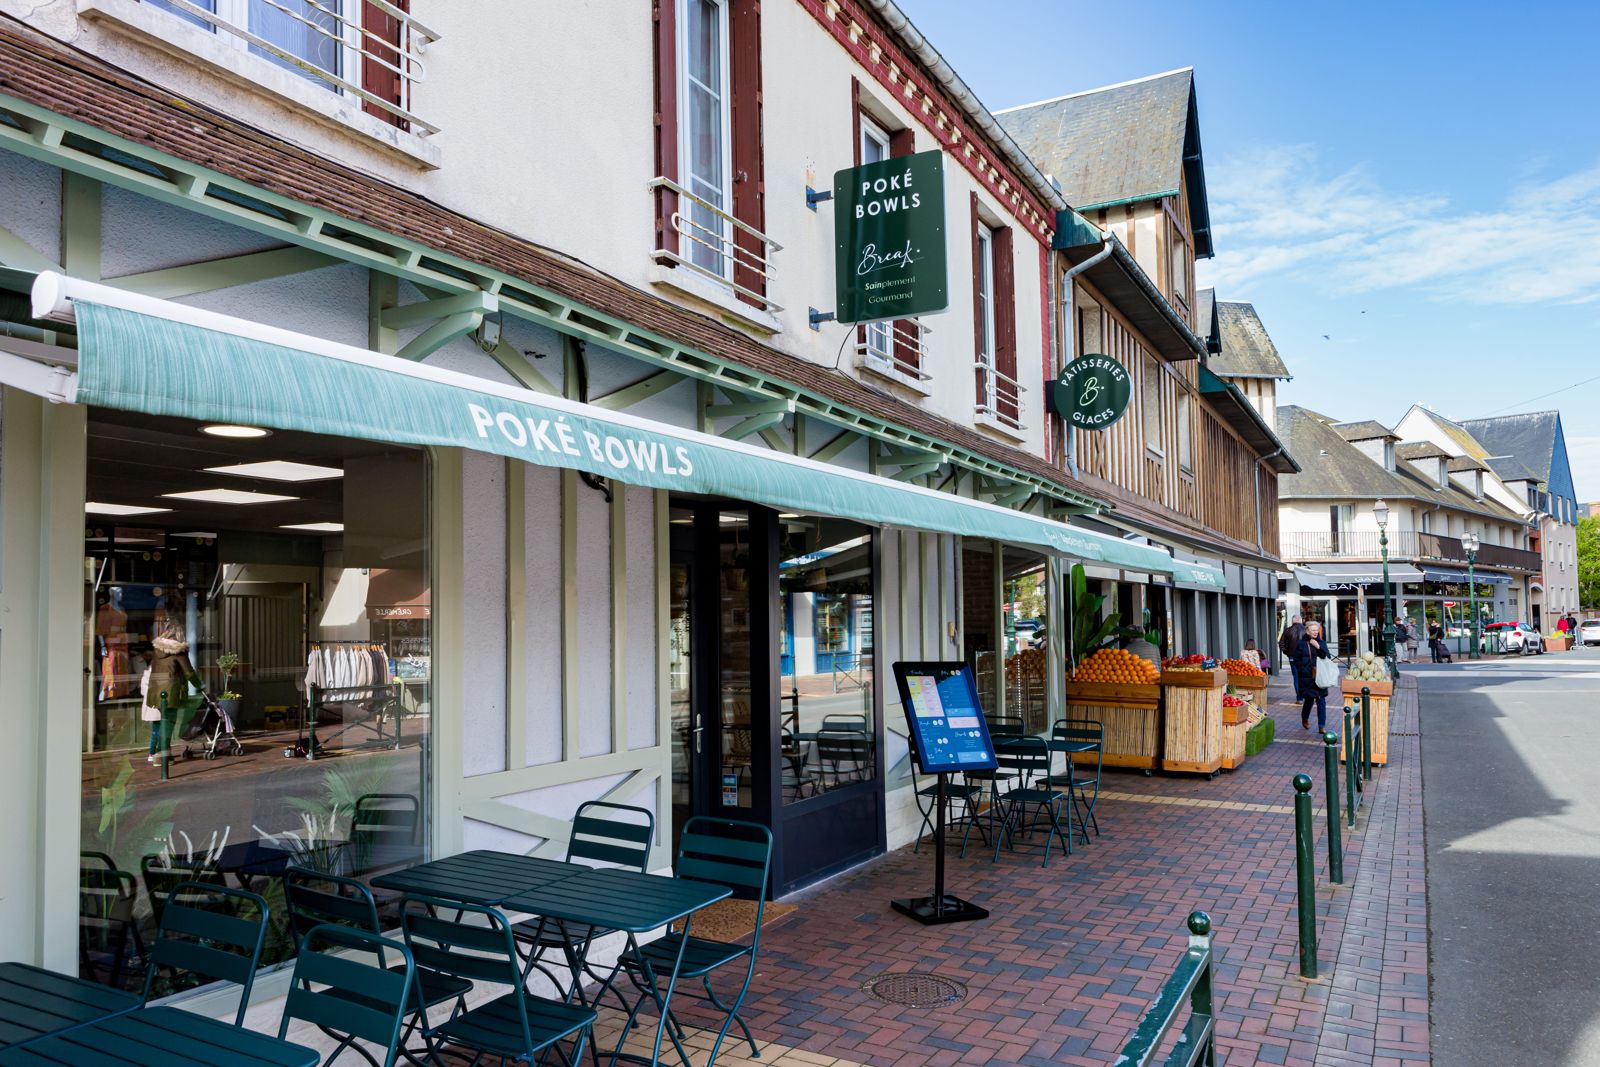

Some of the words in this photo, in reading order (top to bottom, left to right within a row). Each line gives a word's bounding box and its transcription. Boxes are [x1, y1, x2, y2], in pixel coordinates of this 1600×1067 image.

[862, 168, 913, 197] POKÉ
[856, 193, 921, 219] BOWLS
[865, 276, 916, 291] Sainplement
[868, 291, 913, 305] Gourmand
[1061, 359, 1125, 387] PÂTISSERIES
[1072, 408, 1115, 424] GLACES
[468, 403, 581, 457] POKÉ
[582, 430, 693, 477] BOWLS
